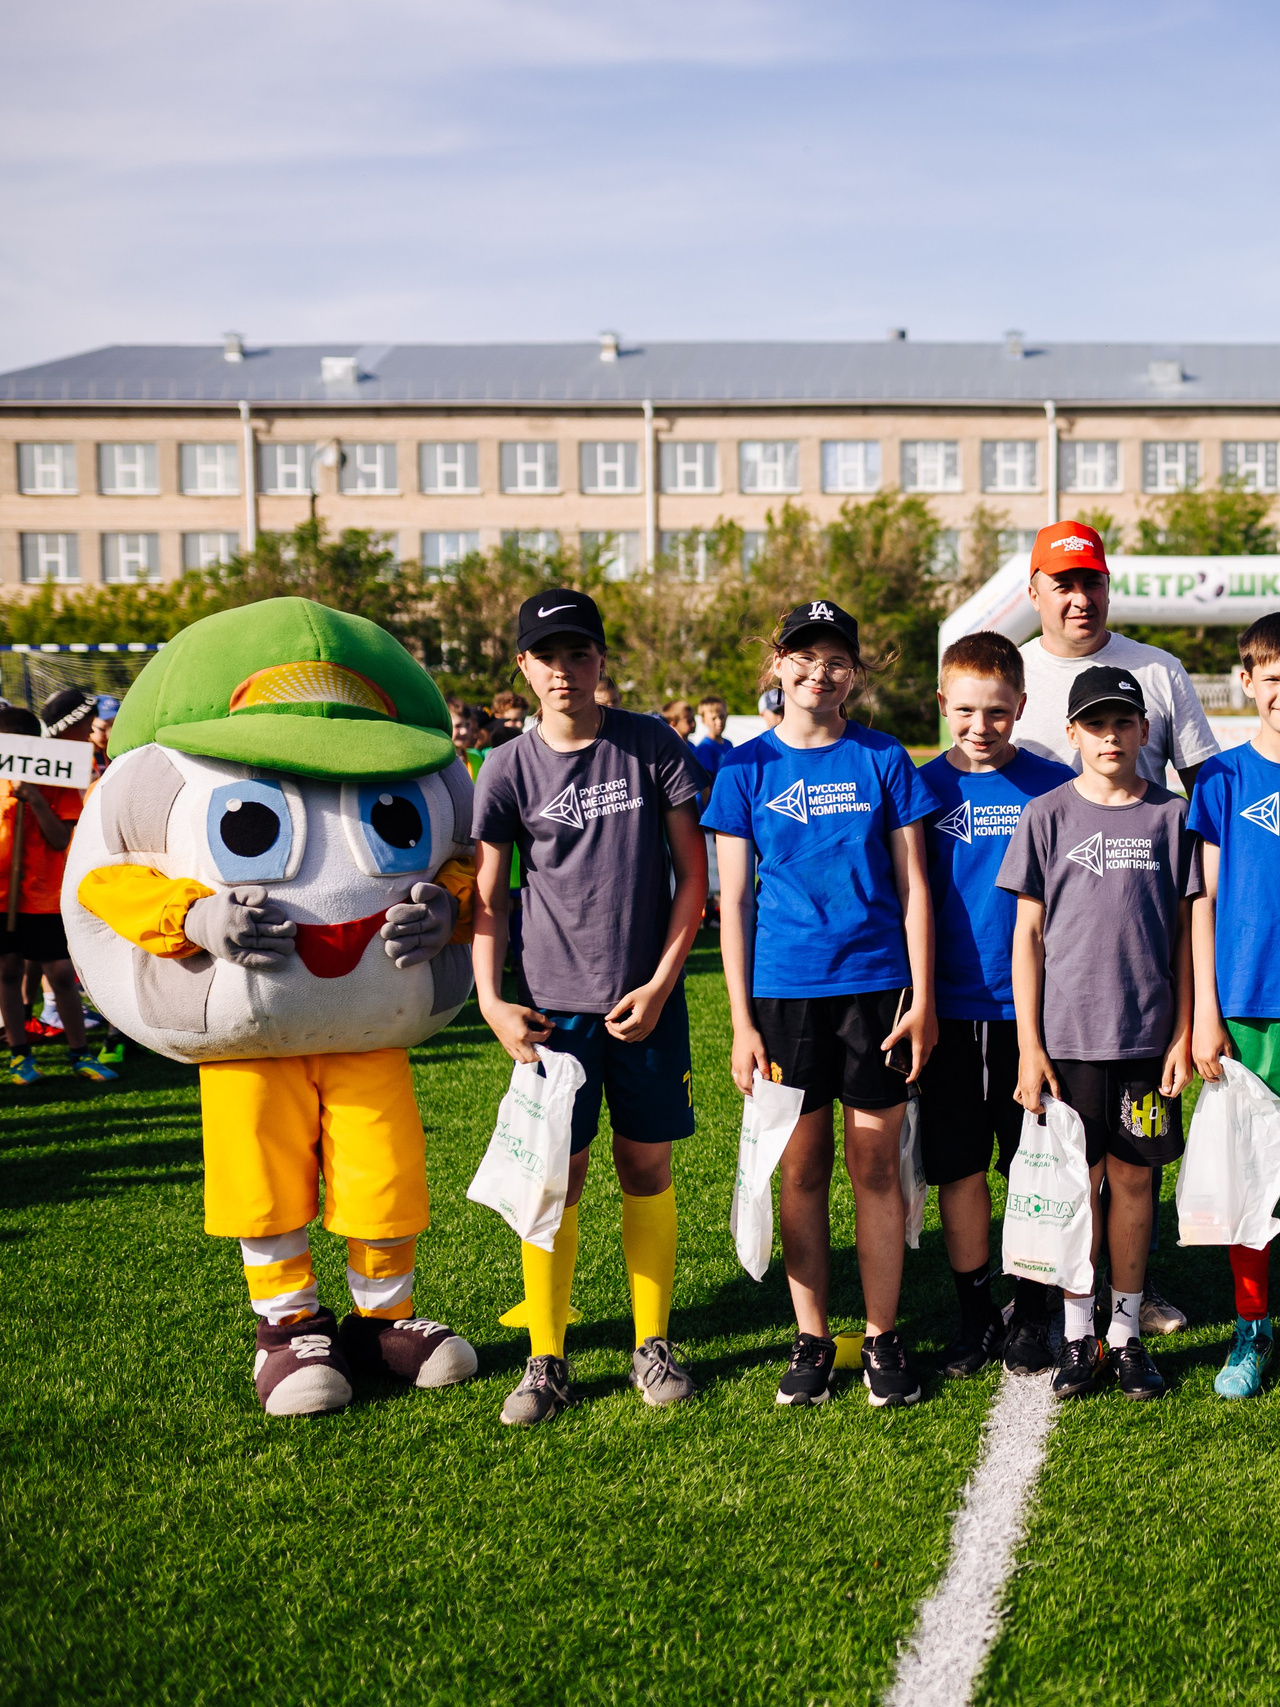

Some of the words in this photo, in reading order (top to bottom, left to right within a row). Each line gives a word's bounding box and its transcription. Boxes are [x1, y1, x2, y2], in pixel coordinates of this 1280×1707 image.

[808, 601, 834, 621] LA
[579, 778, 628, 798] РУССКАЯ
[807, 782, 857, 795] РУССКАЯ
[581, 790, 628, 809] МЕДНАЯ
[808, 792, 856, 806] МЕДНАЯ
[584, 797, 644, 820] КОМПАНИЯ
[810, 802, 872, 816] КОМПАНИЯ
[973, 805, 1021, 816] РУССКАЯ
[973, 815, 1020, 826] МЕДНАЯ
[974, 826, 1015, 837] КОМПА
[1105, 838, 1152, 849] РУССКАЯ
[1105, 848, 1150, 859] МЕДНАЯ
[1106, 859, 1161, 871] КОМПАНИЯ
